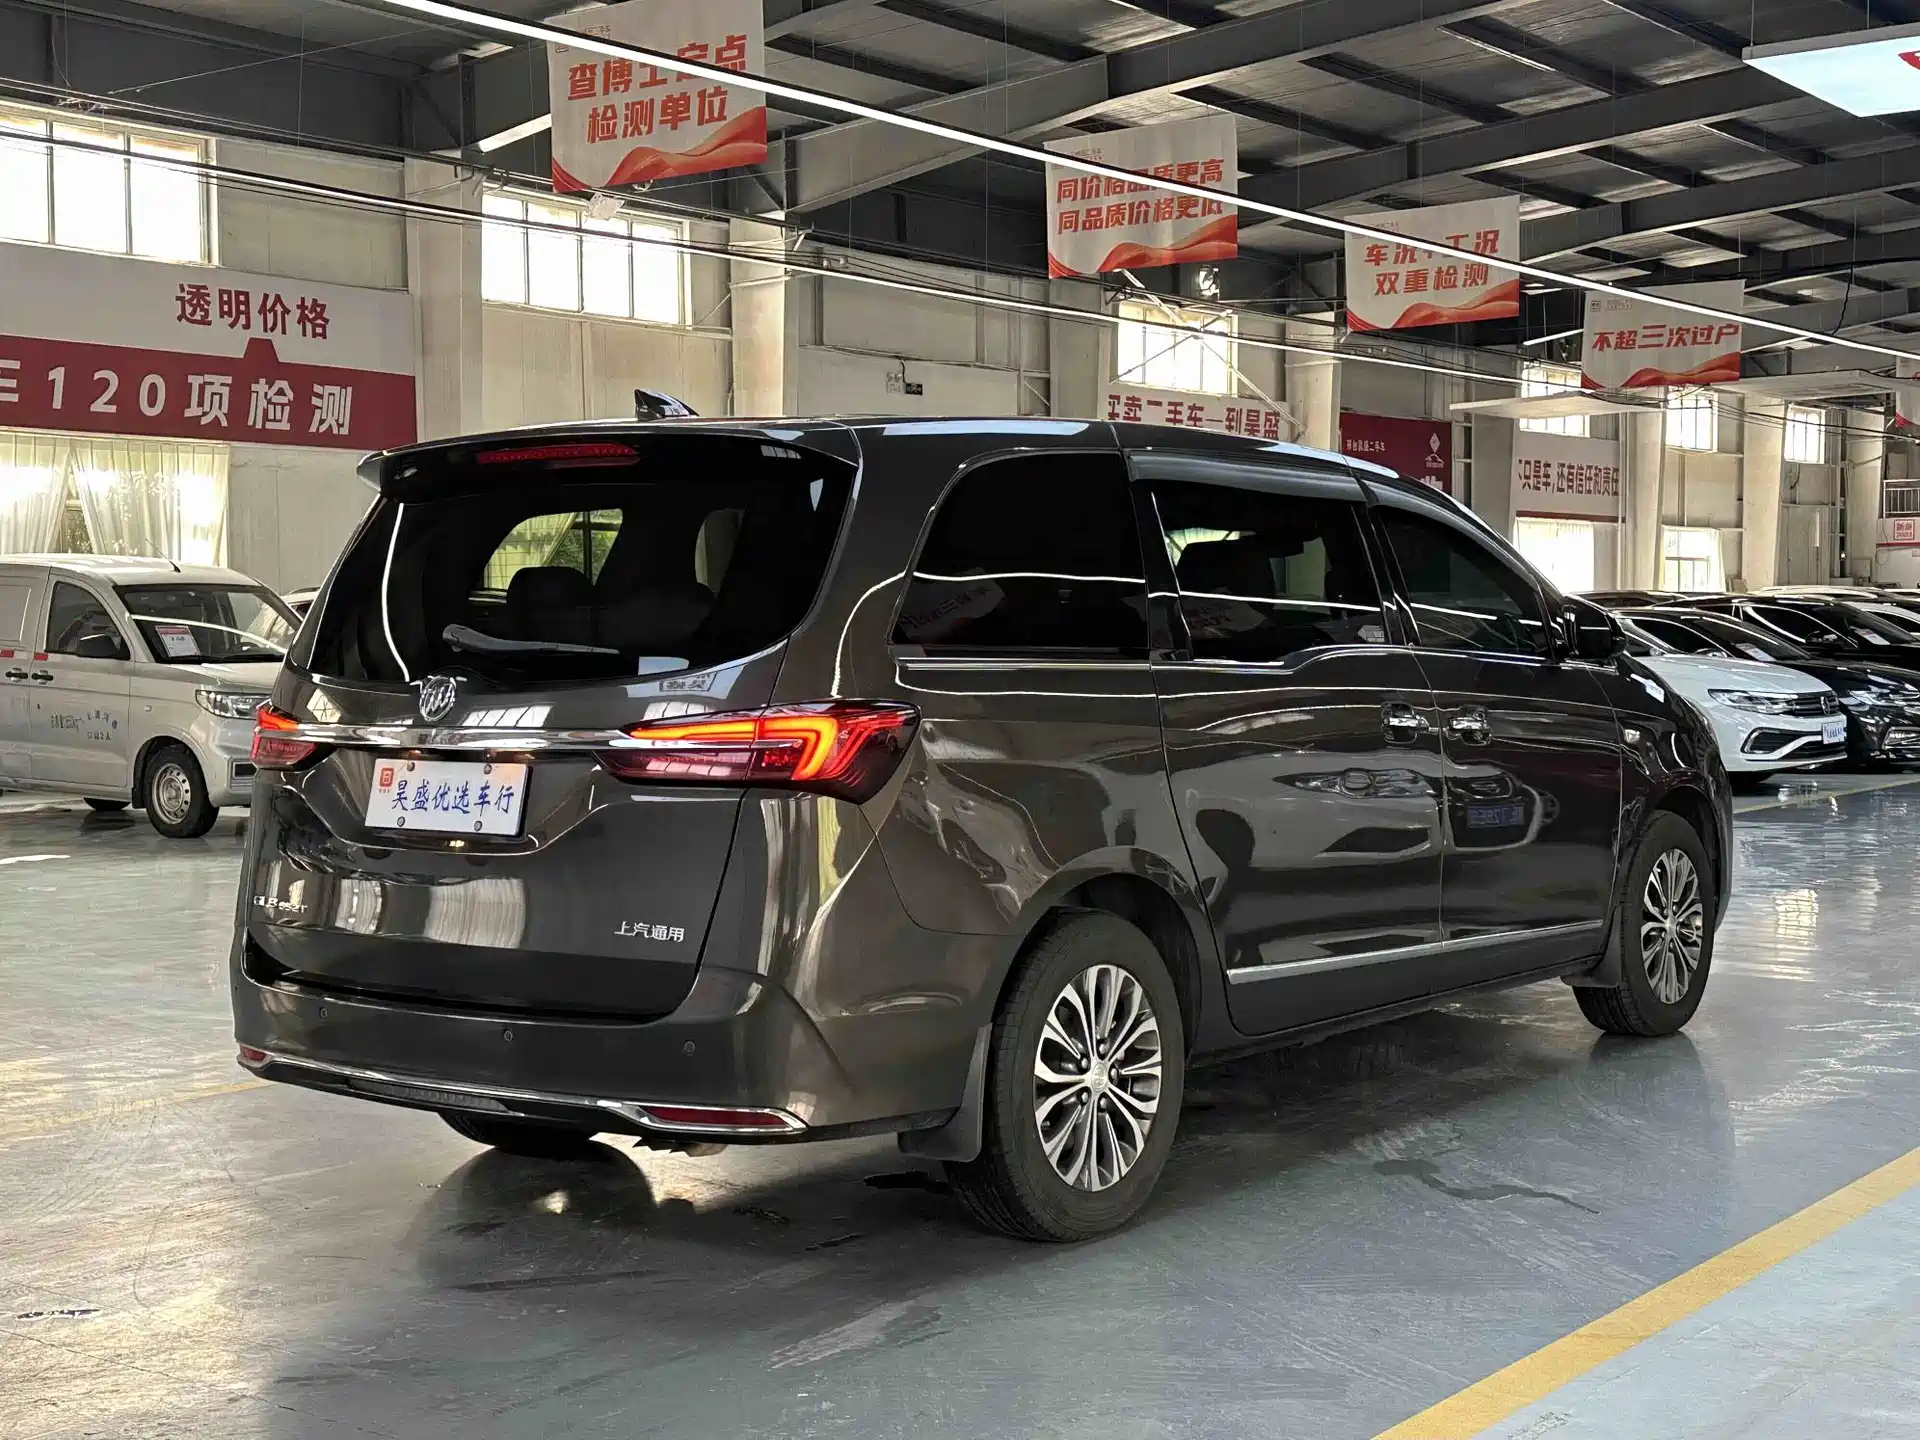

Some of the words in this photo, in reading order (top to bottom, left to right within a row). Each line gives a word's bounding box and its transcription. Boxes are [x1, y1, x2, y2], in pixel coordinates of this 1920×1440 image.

[587, 85, 728, 144] 检测单位
[1058, 196, 1223, 234] 同品质价格更低
[1364, 229, 1501, 266] 车况工况
[1374, 263, 1489, 296] 双重检测
[175, 283, 331, 340] 透明价格
[1592, 324, 1740, 352] 不超三次过户
[391, 779, 515, 816] 昊盛优选车行
[614, 921, 685, 942] 上汽通用
